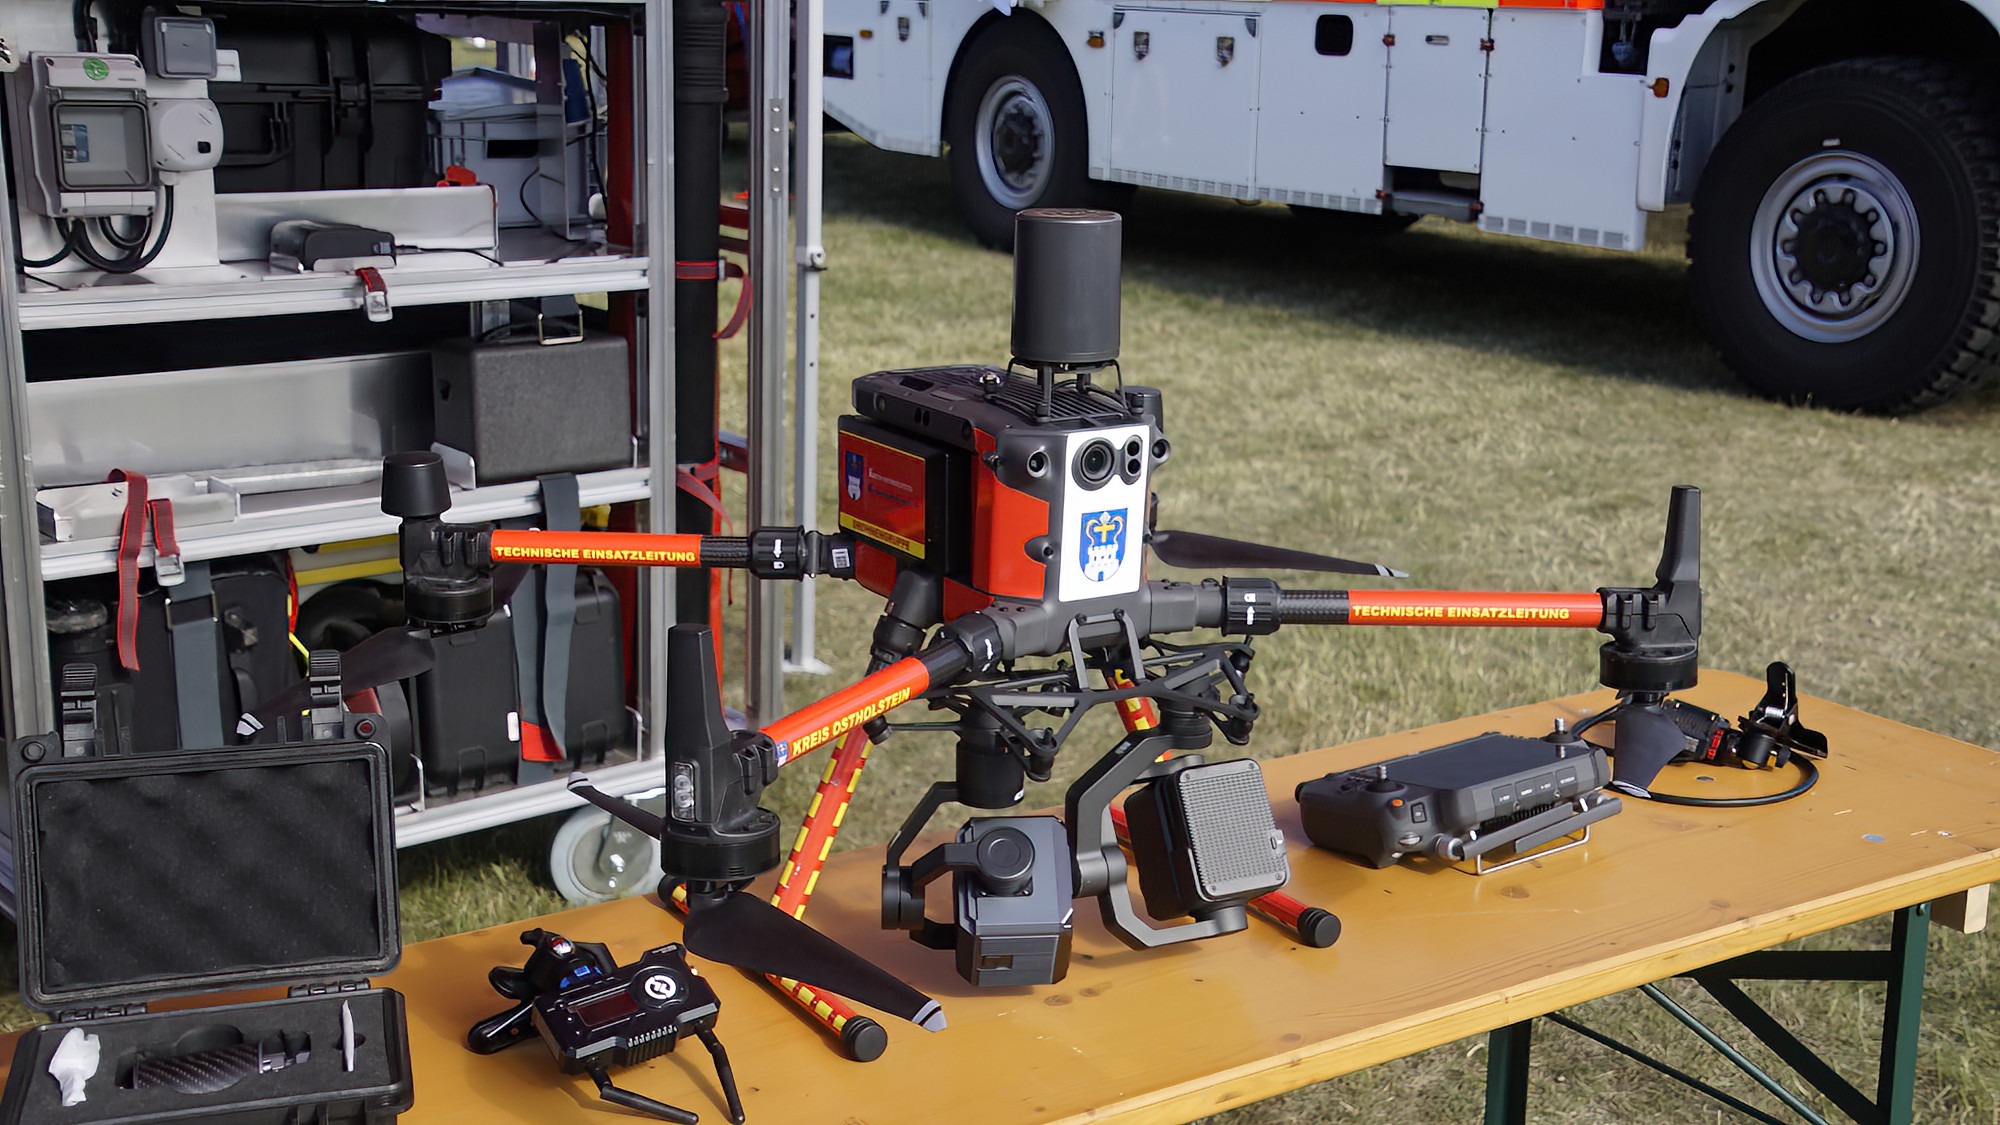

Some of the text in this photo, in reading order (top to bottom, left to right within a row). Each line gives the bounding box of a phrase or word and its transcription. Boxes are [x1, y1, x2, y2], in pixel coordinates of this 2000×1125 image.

[495, 546, 695, 562] TECHNISCHE EINSATZLEITUNG
[1352, 605, 1570, 619] TECHNISCHE EINSATZLEITUNG
[792, 687, 911, 756] KREIS OSTHOLSTEIN
